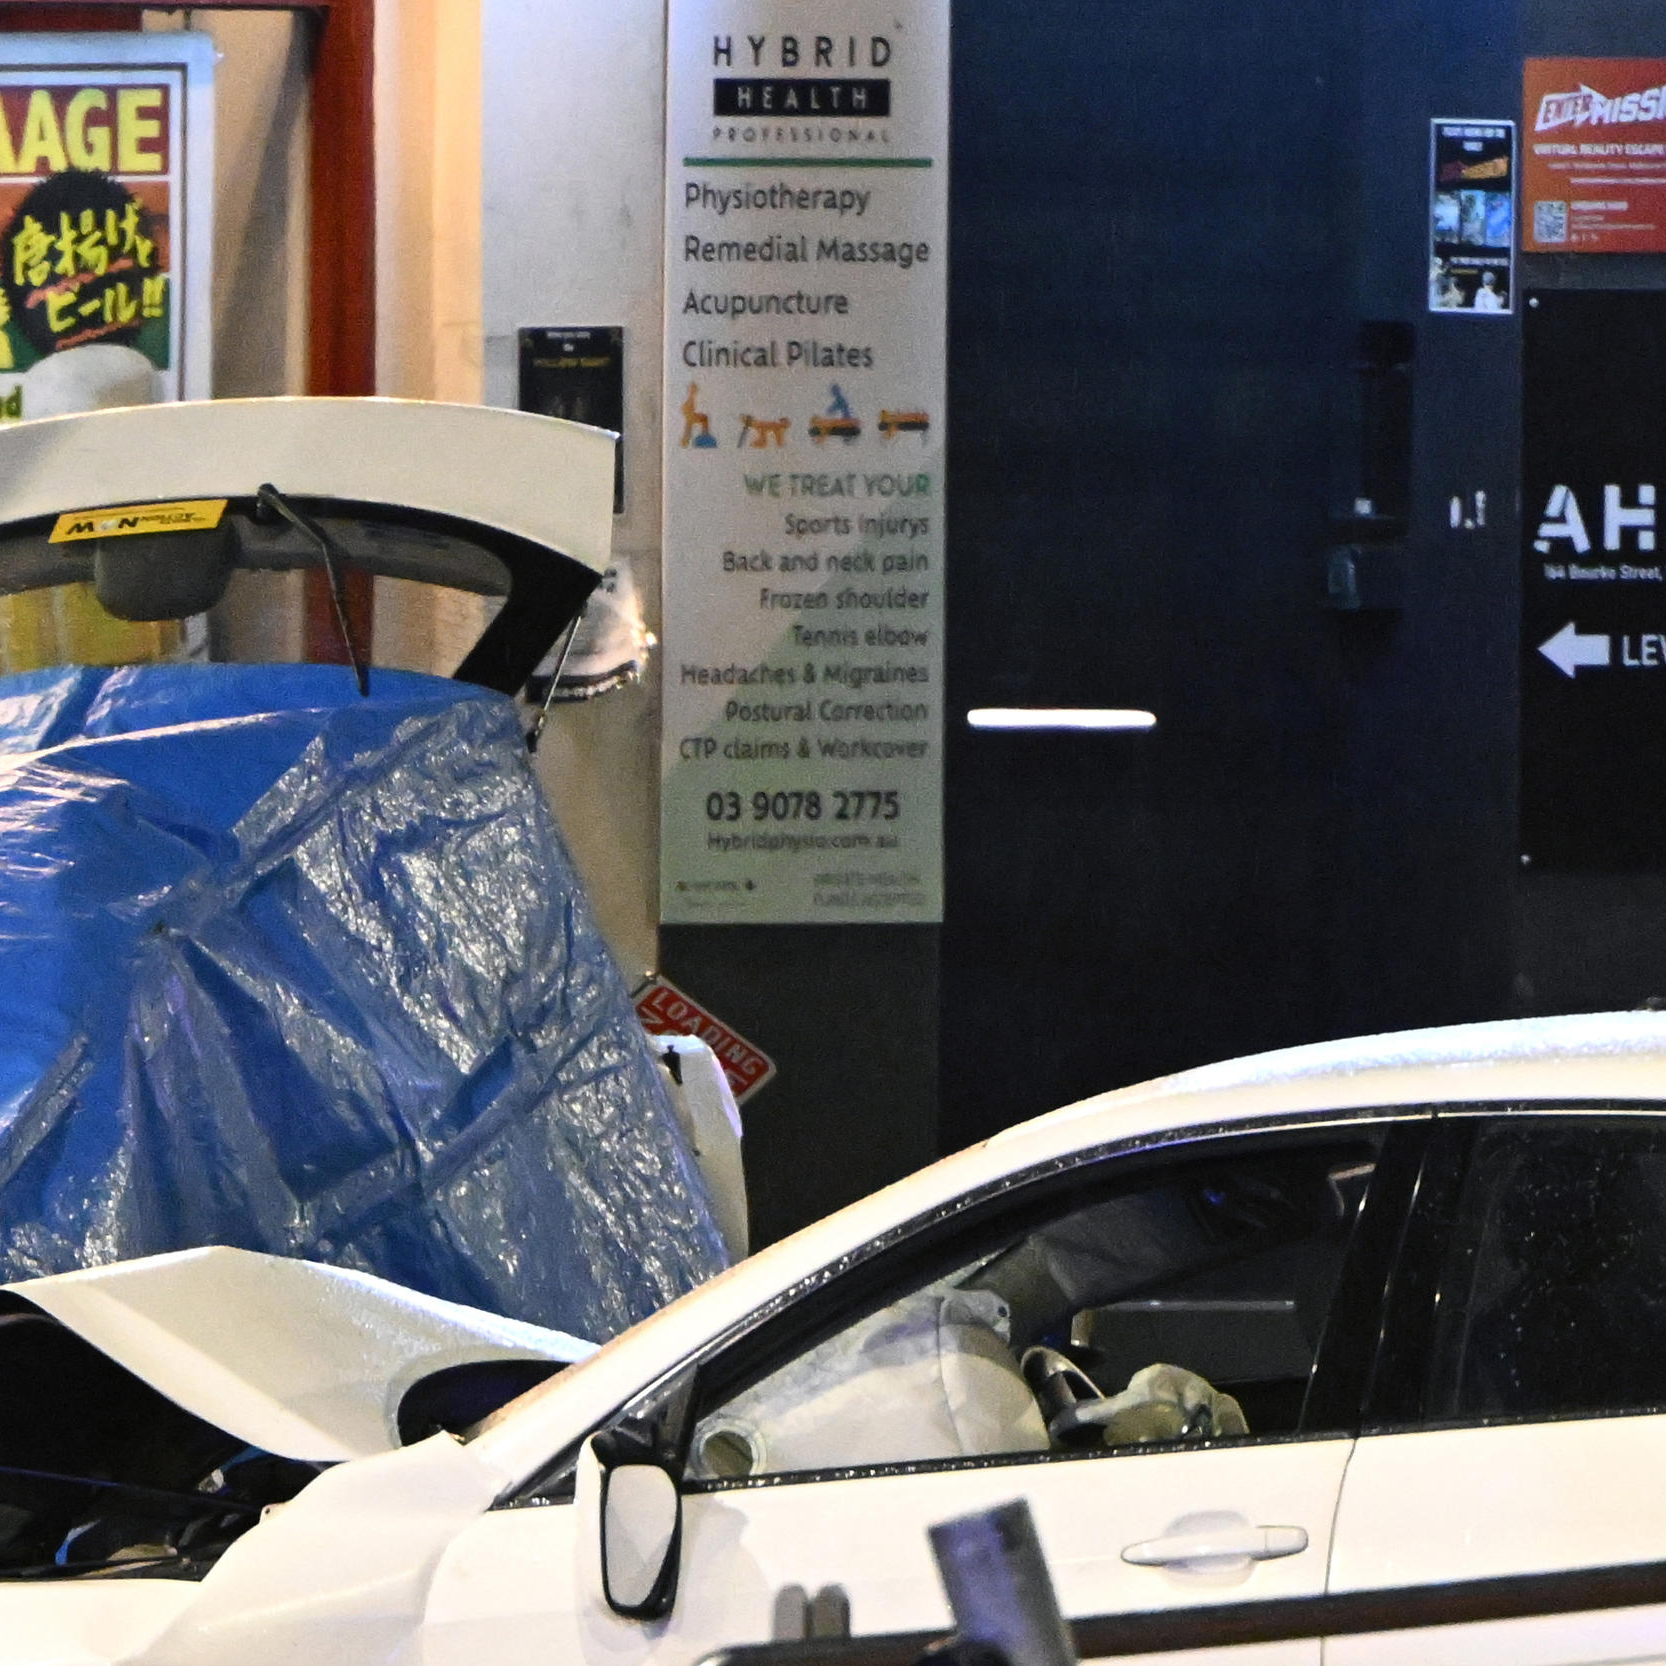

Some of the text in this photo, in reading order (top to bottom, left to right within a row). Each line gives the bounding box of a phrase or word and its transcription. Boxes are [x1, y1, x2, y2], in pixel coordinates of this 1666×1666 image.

[713, 35, 893, 68] HYBRID
[737, 85, 867, 110] HEALTH
[684, 181, 871, 216] Physiotherapy
[683, 235, 930, 270] Remedial Massage
[682, 289, 849, 319] Acupuncture
[682, 340, 874, 368] Clinical Pilates
[744, 473, 930, 497] WE TREAT YOUR
[784, 513, 850, 538] Sports
[723, 551, 928, 575] Back and neck pain
[835, 587, 929, 609] shoulder
[794, 626, 927, 647] Tennis elbow
[680, 662, 795, 686] Headaches
[823, 663, 928, 689] Migraines
[723, 738, 790, 763] claims
[706, 792, 901, 821] 03 9078 2775
[652, 991, 763, 1075] LOADING
